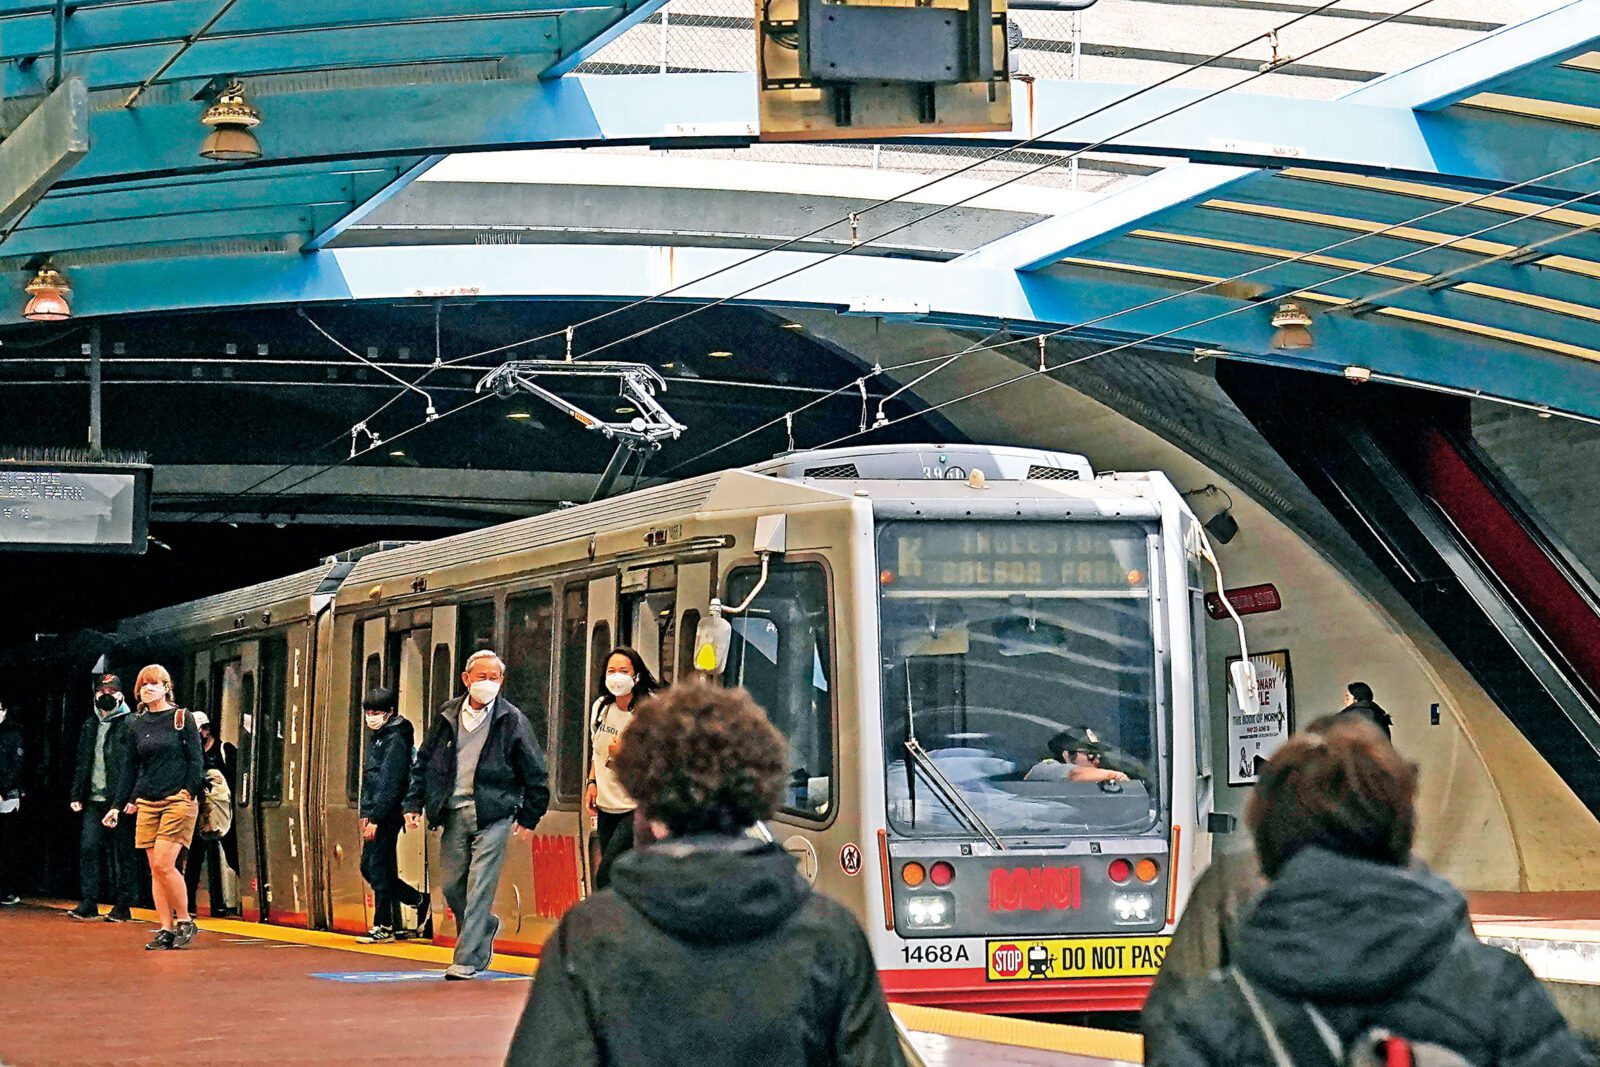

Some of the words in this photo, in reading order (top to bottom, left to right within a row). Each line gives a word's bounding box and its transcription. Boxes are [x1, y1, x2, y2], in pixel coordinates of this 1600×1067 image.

[898, 537, 922, 577] K
[1256, 677, 1277, 690] ONARY
[900, 944, 969, 963] 1468A
[995, 950, 1022, 972] STOP
[1062, 947, 1086, 970] DO
[1092, 946, 1126, 969] NOT
[1131, 945, 1169, 968] PAS
